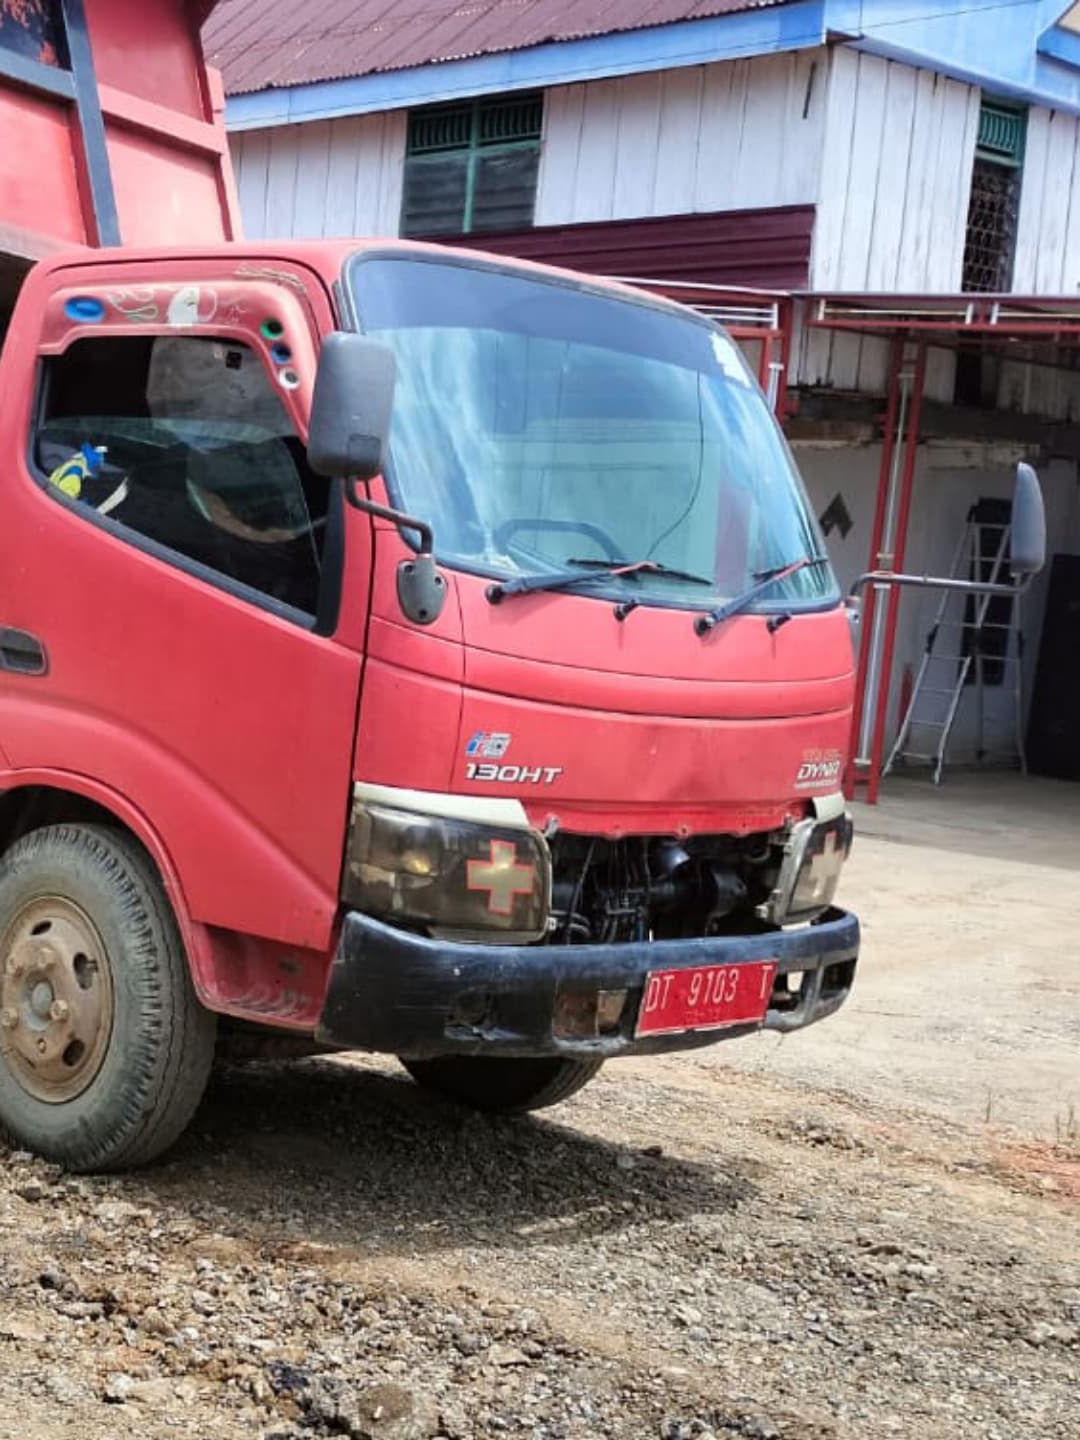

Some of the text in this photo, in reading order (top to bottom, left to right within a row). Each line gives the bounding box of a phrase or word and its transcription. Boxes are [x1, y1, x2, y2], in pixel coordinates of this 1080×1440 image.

[465, 762, 563, 784] 130HT
[796, 760, 841, 779] DYNA
[645, 965, 775, 1013] DT 9103 T
